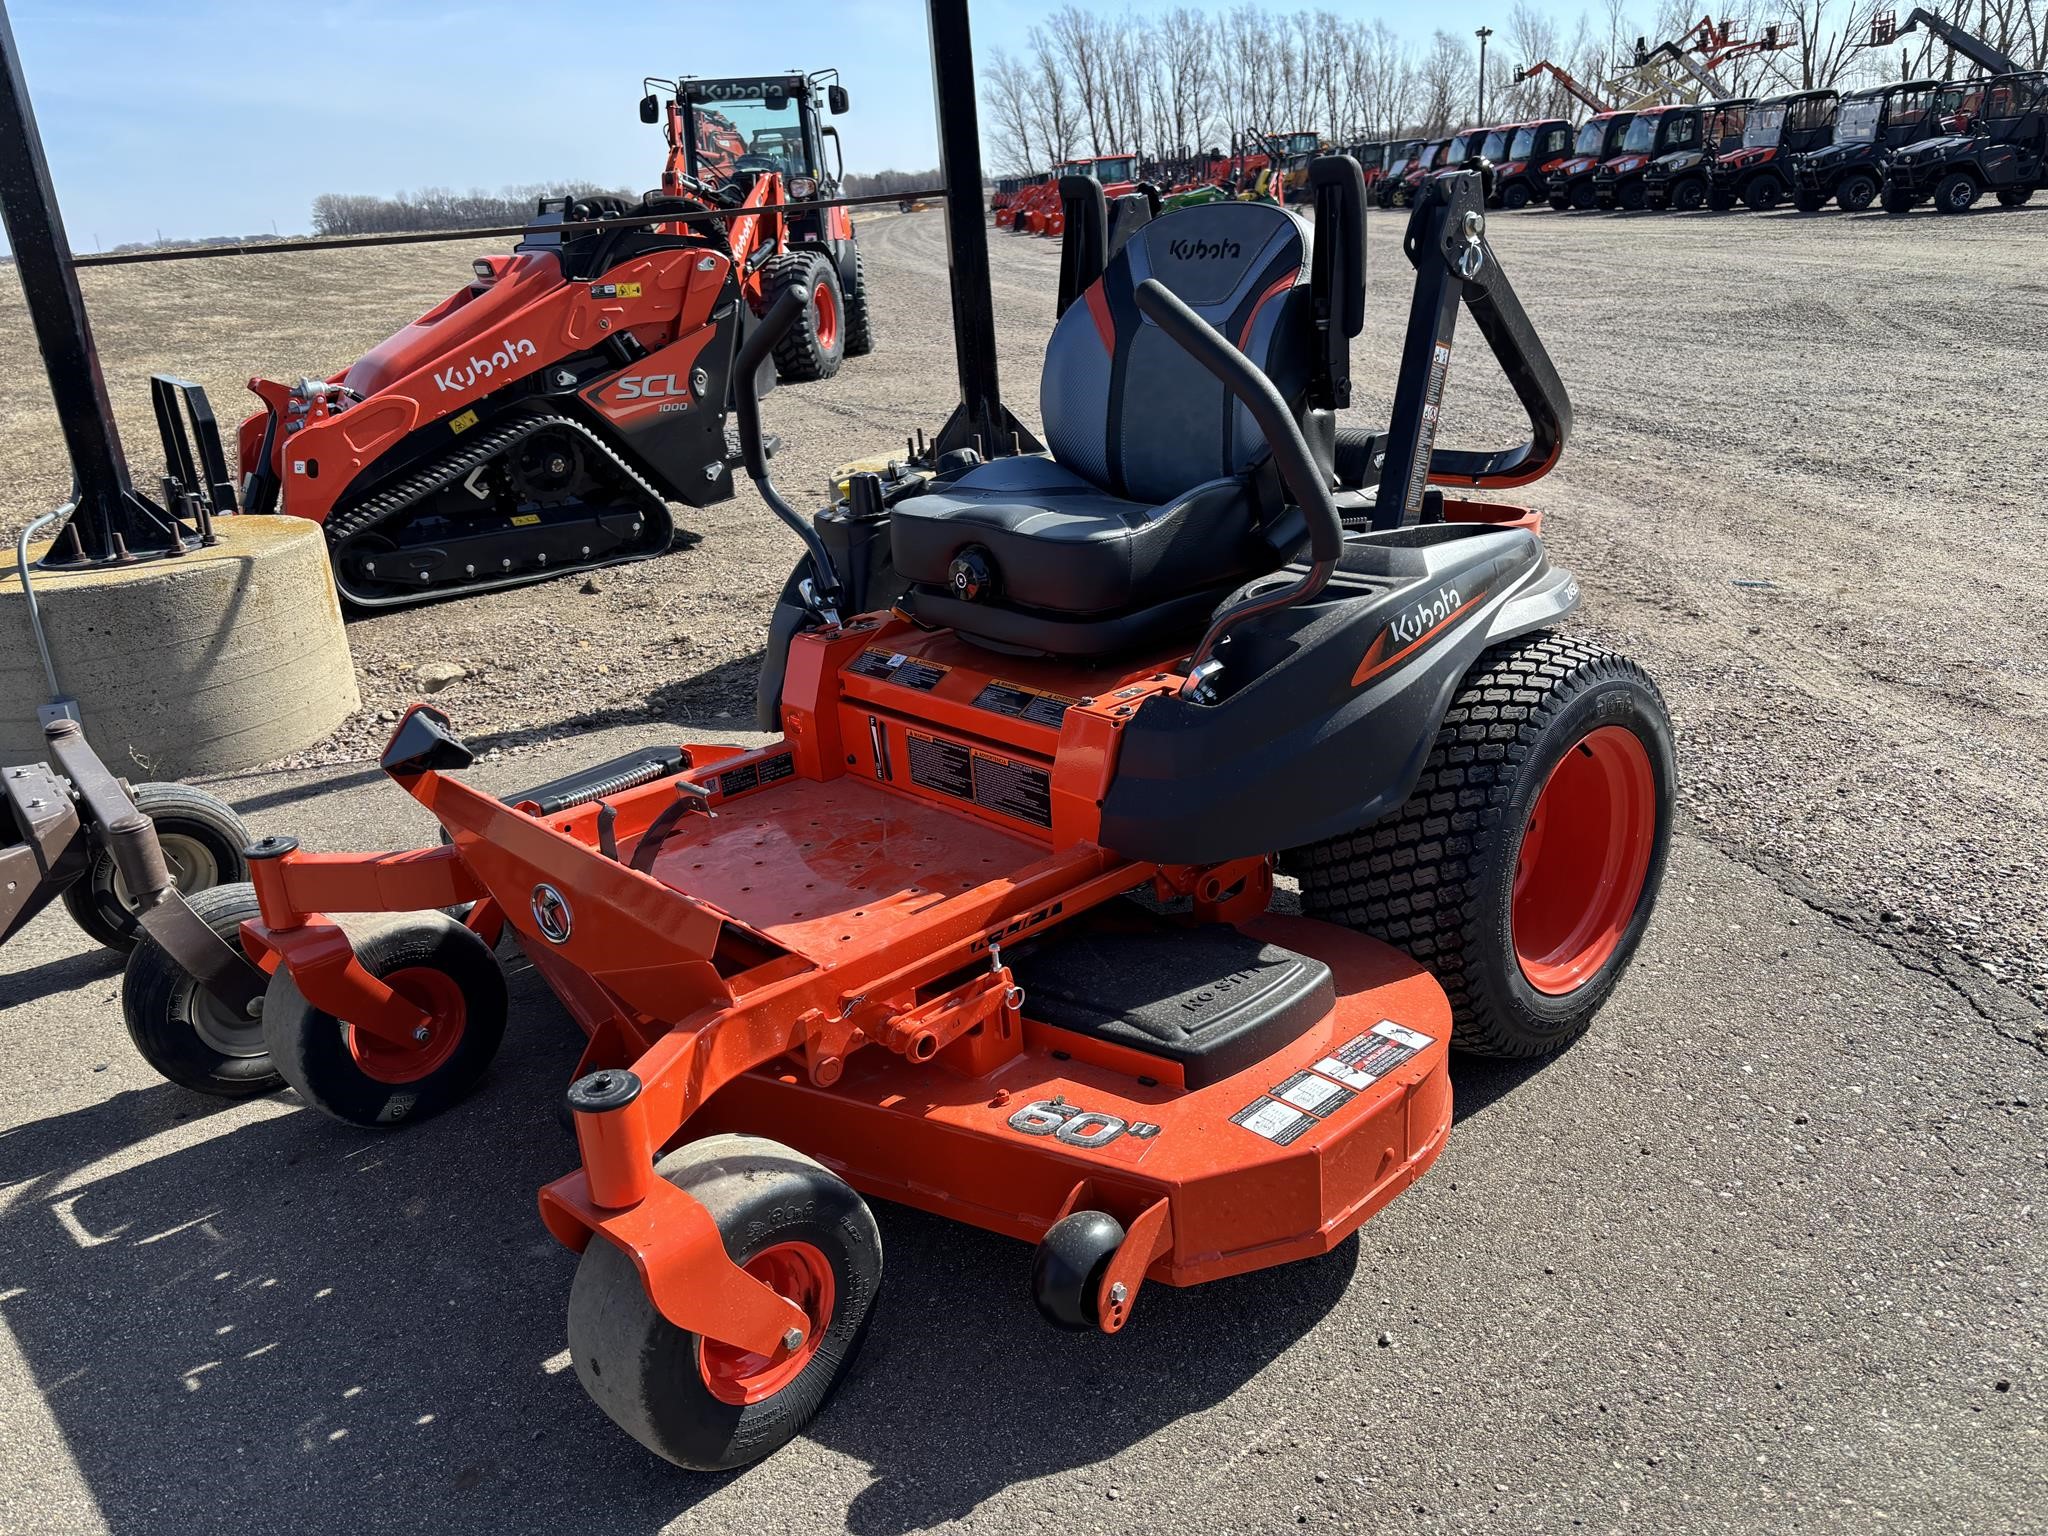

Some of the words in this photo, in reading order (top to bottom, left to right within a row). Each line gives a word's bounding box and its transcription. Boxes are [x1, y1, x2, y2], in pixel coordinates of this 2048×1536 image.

[701, 82, 784, 100] Kubota
[1169, 238, 1241, 260] Kubota
[434, 339, 537, 392] Kubota
[615, 374, 688, 400] SCL
[658, 402, 688, 413] 1000
[1390, 587, 1462, 643] Kubota
[1181, 992, 1216, 1012] NO
[1007, 1099, 1162, 1149] 60"
